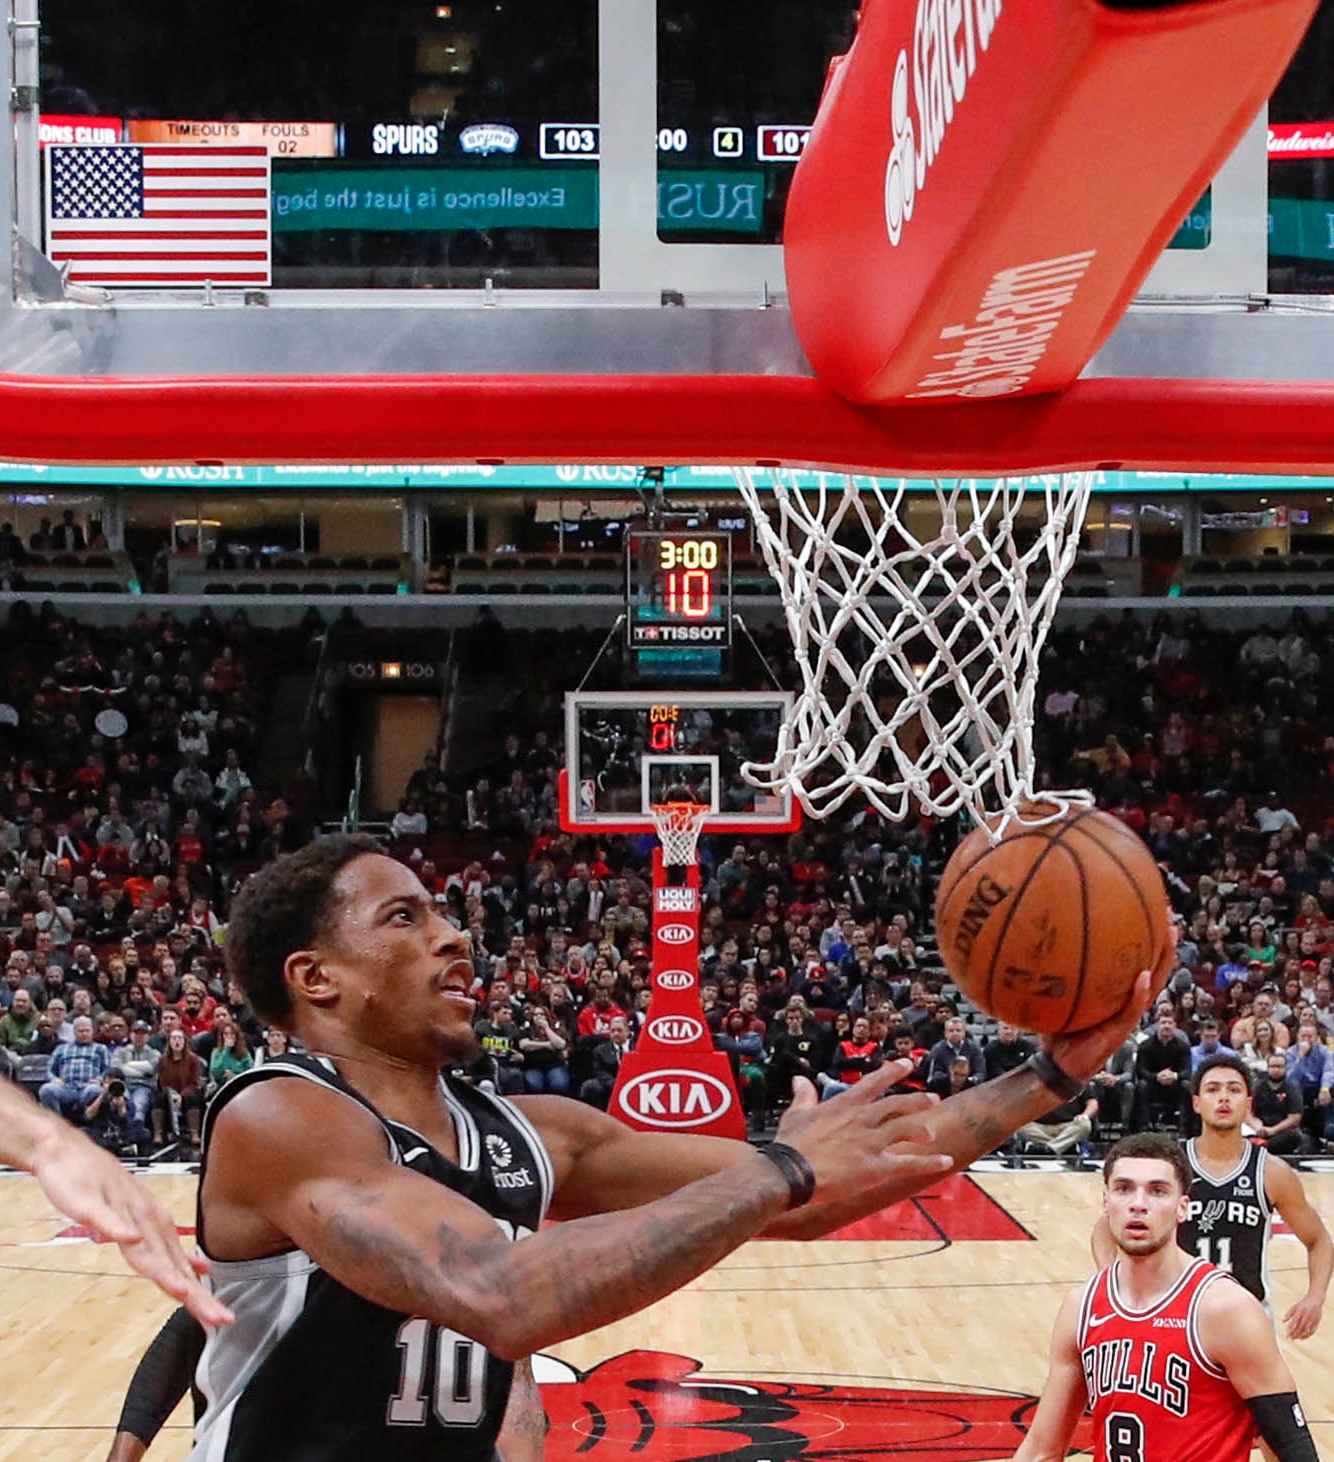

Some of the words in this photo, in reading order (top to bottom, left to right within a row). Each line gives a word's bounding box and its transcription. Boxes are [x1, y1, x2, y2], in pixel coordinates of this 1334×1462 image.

[76, 125, 116, 144] CLUB
[168, 123, 240, 137] TIMEOUTS
[261, 124, 309, 137] FOULS
[372, 124, 438, 154] SPURS
[278, 141, 297, 154] 02
[553, 130, 595, 152] 103
[720, 132, 734, 150] 4
[660, 540, 718, 570] 3:00
[667, 570, 711, 617] 10
[660, 627, 726, 641] TISSOT
[659, 888, 692, 901] LIQUI
[658, 900, 693, 912] MOLY
[664, 928, 688, 940] KIA
[664, 974, 688, 986] KIA
[657, 1019, 694, 1038] KIA
[638, 1083, 713, 1114] KIA
[491, 1166, 535, 1189] Frost
[1187, 1199, 1261, 1233] PURS
[1196, 1237, 1234, 1273] 11
[386, 1315, 489, 1428] 10
[1082, 1338, 1191, 1418] BULLS
